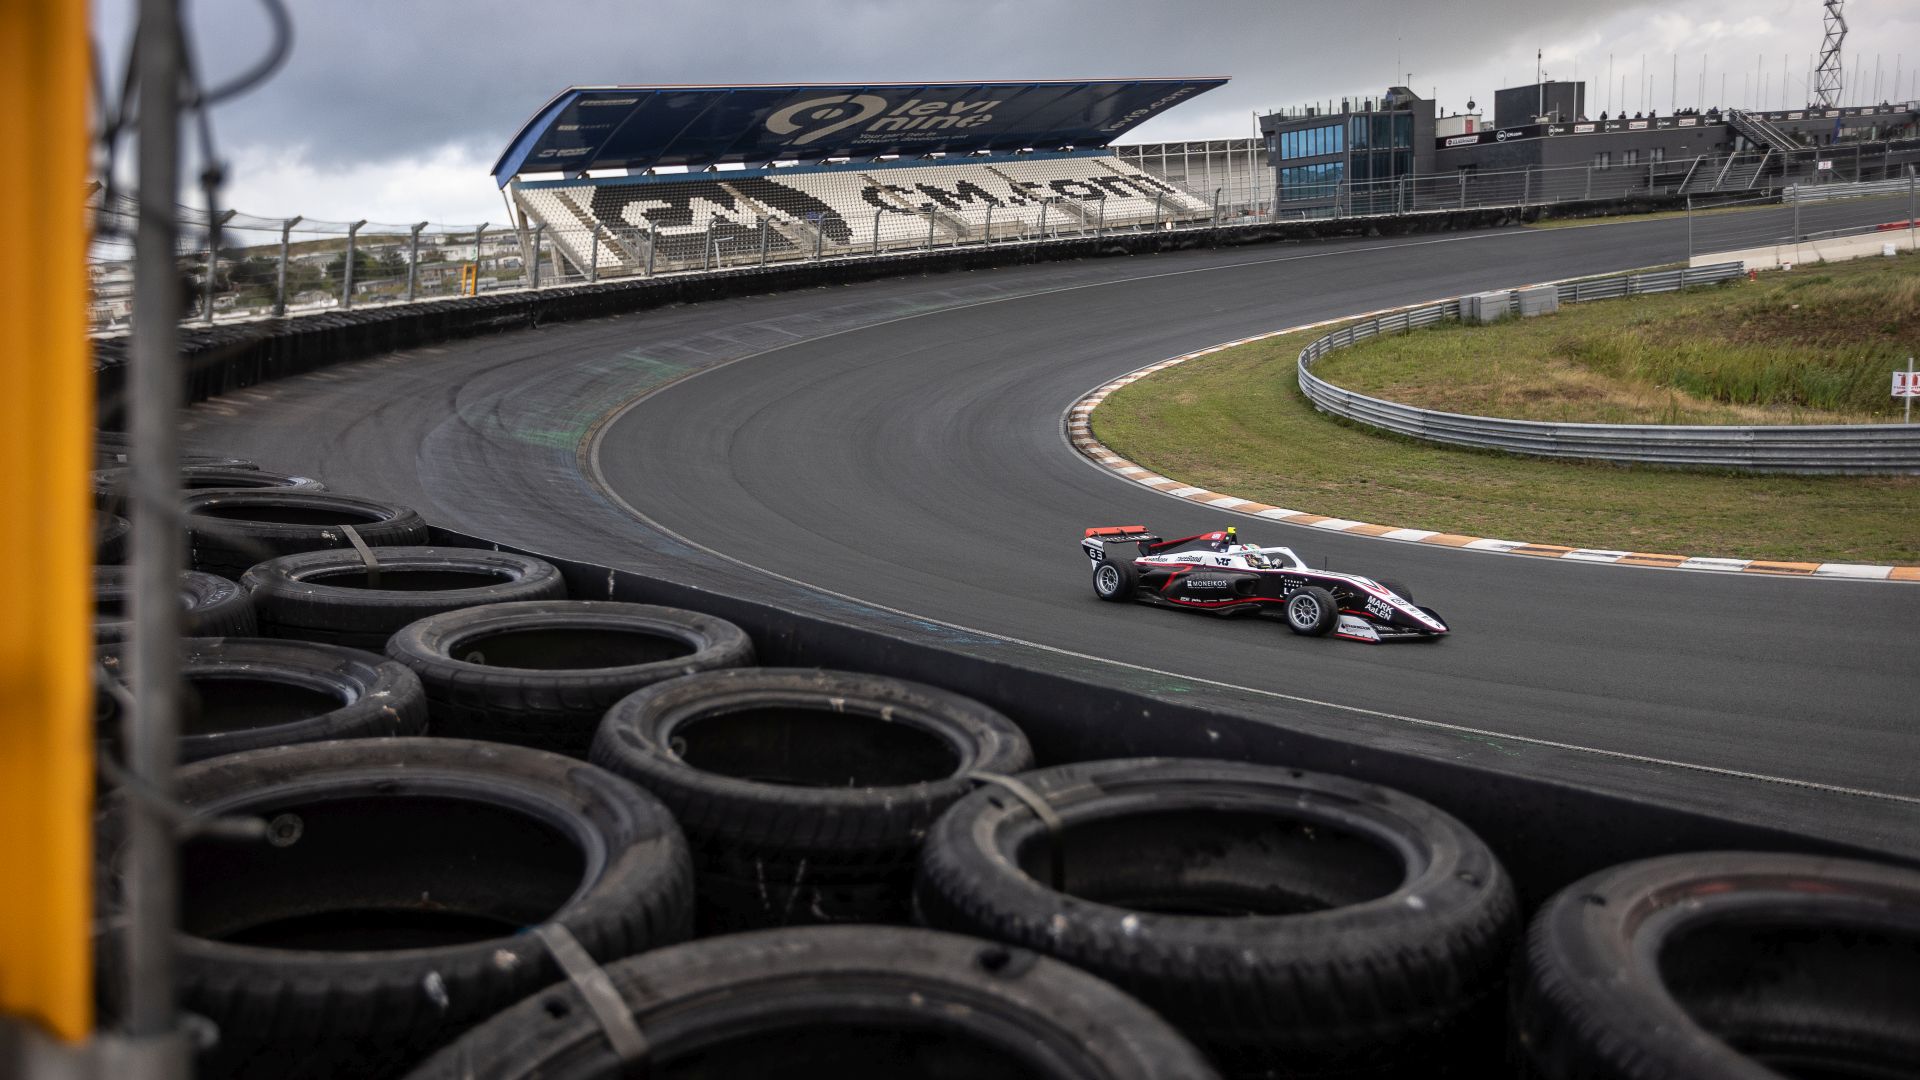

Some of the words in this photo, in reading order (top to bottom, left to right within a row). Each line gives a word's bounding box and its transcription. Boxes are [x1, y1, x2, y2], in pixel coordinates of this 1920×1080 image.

[888, 99, 1001, 116] levi
[866, 114, 992, 131] nine
[1089, 549, 1103, 560] 63
[1365, 603, 1391, 621] AaLEN
[1367, 595, 1394, 614] MARK
